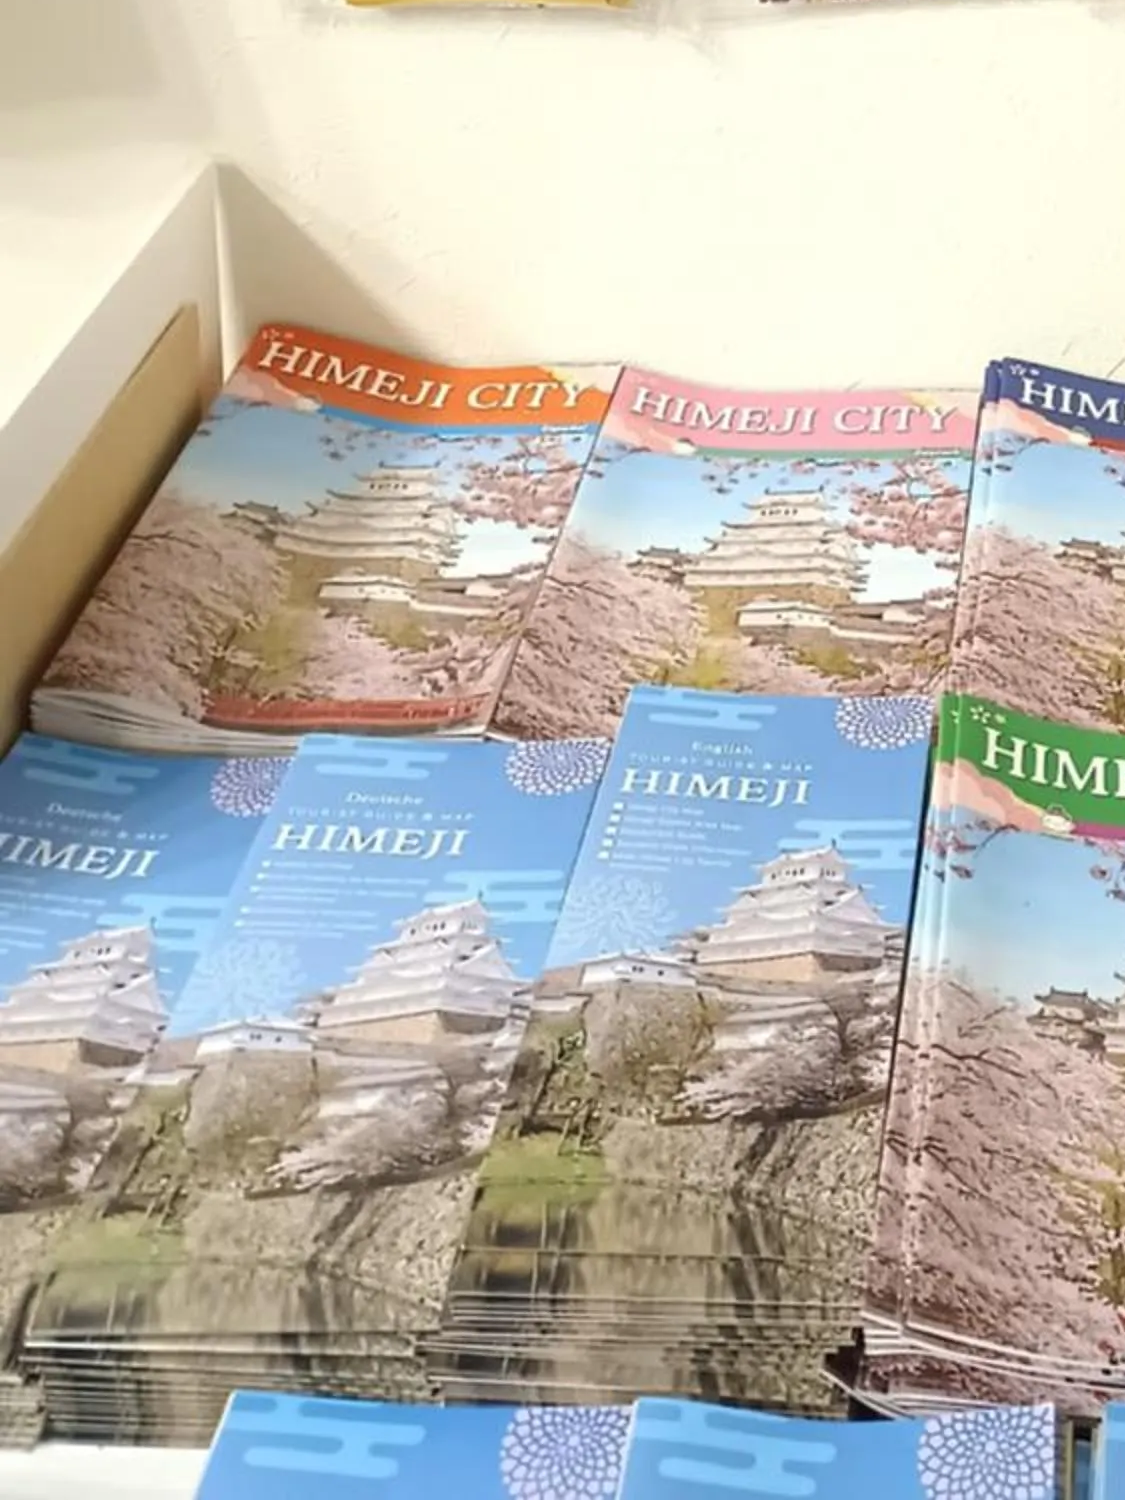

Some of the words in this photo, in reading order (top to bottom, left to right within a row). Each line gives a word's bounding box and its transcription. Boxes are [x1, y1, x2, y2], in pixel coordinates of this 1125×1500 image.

[258, 340, 455, 409] HIMEJI
[467, 381, 595, 410] CITY
[630, 385, 825, 434] HIMEJI
[833, 405, 959, 434] CITY
[691, 740, 754, 758] English
[620, 766, 814, 809] HIMEJI
[0, 832, 161, 881] IMEJI
[270, 822, 472, 861] HIMEJI
